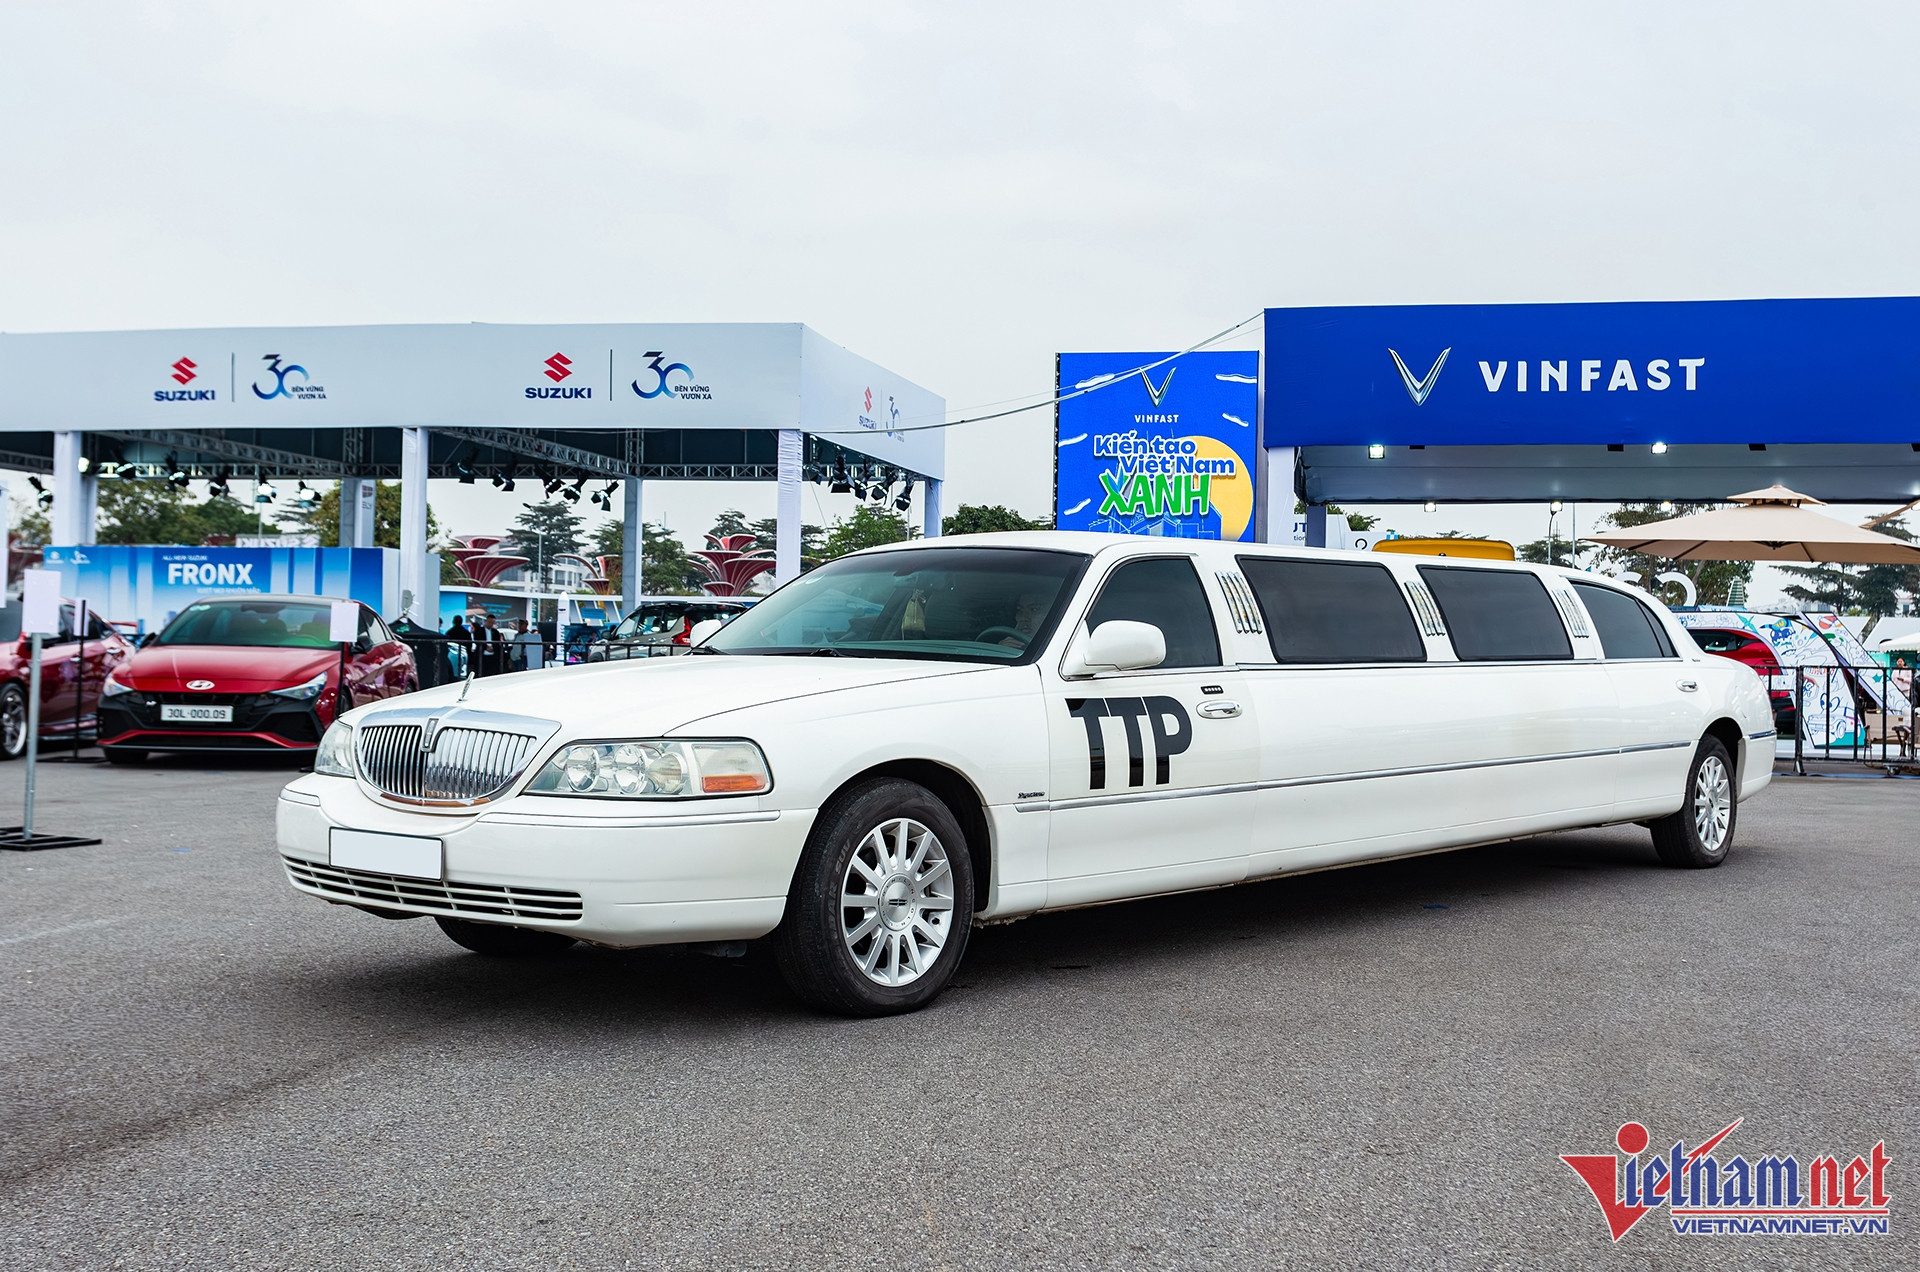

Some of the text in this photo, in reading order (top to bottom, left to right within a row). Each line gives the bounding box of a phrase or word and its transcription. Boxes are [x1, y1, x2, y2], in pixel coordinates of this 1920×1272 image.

[631, 351, 694, 399] 30
[1478, 357, 1706, 392] VINFAST
[154, 390, 216, 401] SUZUKI
[525, 387, 592, 399] SUZUKI
[1134, 414, 1180, 423] VINFAST
[1095, 431, 1149, 455] Kiến
[1119, 454, 1236, 480] Việt Nam
[1100, 472, 1211, 516] XANH
[168, 563, 253, 585] FRONX
[1064, 695, 1193, 790] TTP
